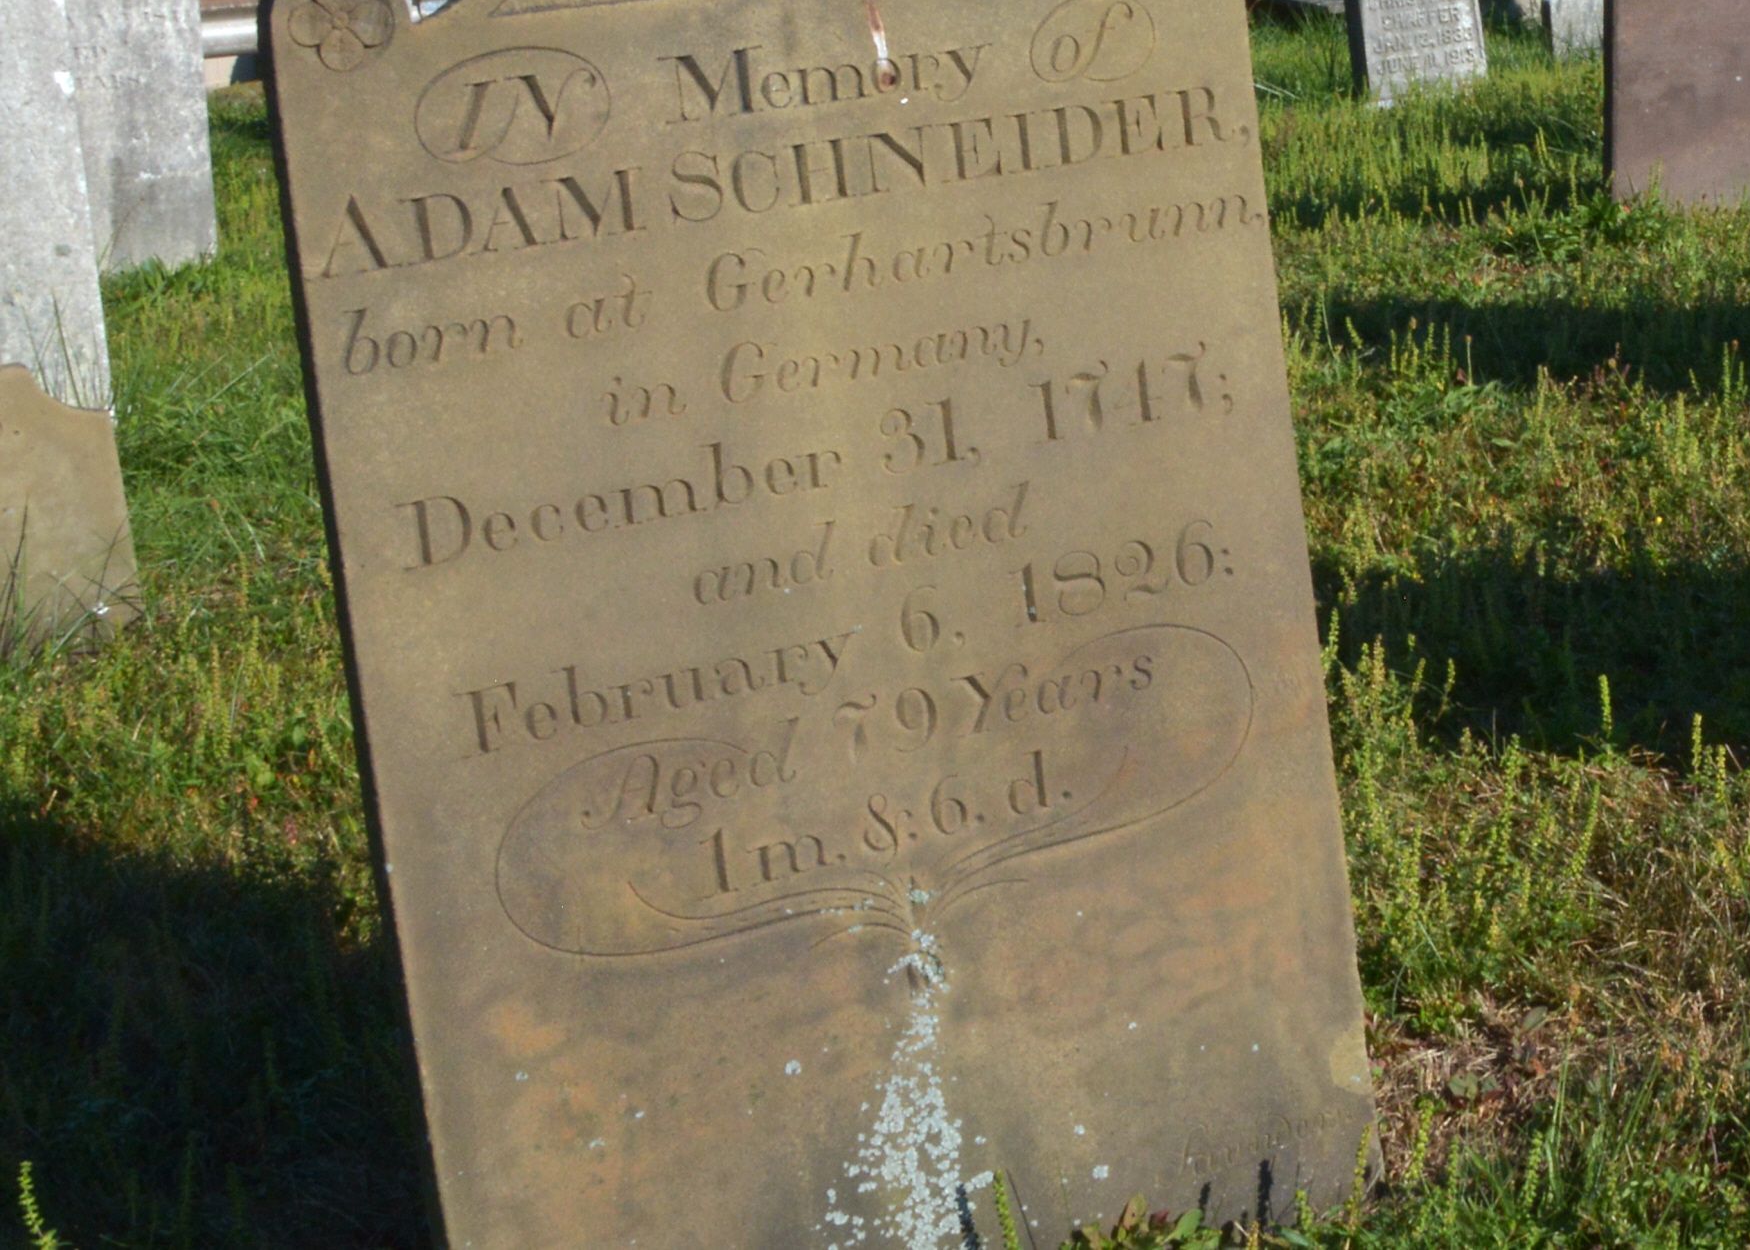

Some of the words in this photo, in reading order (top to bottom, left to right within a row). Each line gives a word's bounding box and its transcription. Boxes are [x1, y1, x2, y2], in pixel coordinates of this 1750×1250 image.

[452, 62, 600, 154] IN
[657, 42, 993, 125] Memory
[304, 166, 648, 280] ADAM
[669, 86, 1251, 223] SCHNEIDER,
[343, 307, 524, 376] born
[565, 274, 652, 339] at
[601, 375, 687, 426] in
[720, 319, 1044, 404] Germany,
[395, 441, 842, 572] December
[879, 396, 982, 474] 31,
[693, 519, 837, 606] and
[867, 480, 1030, 568] died
[454, 630, 858, 759] February
[581, 715, 800, 830] Aged
[832, 686, 938, 764] 79
[949, 653, 1154, 739] Years
